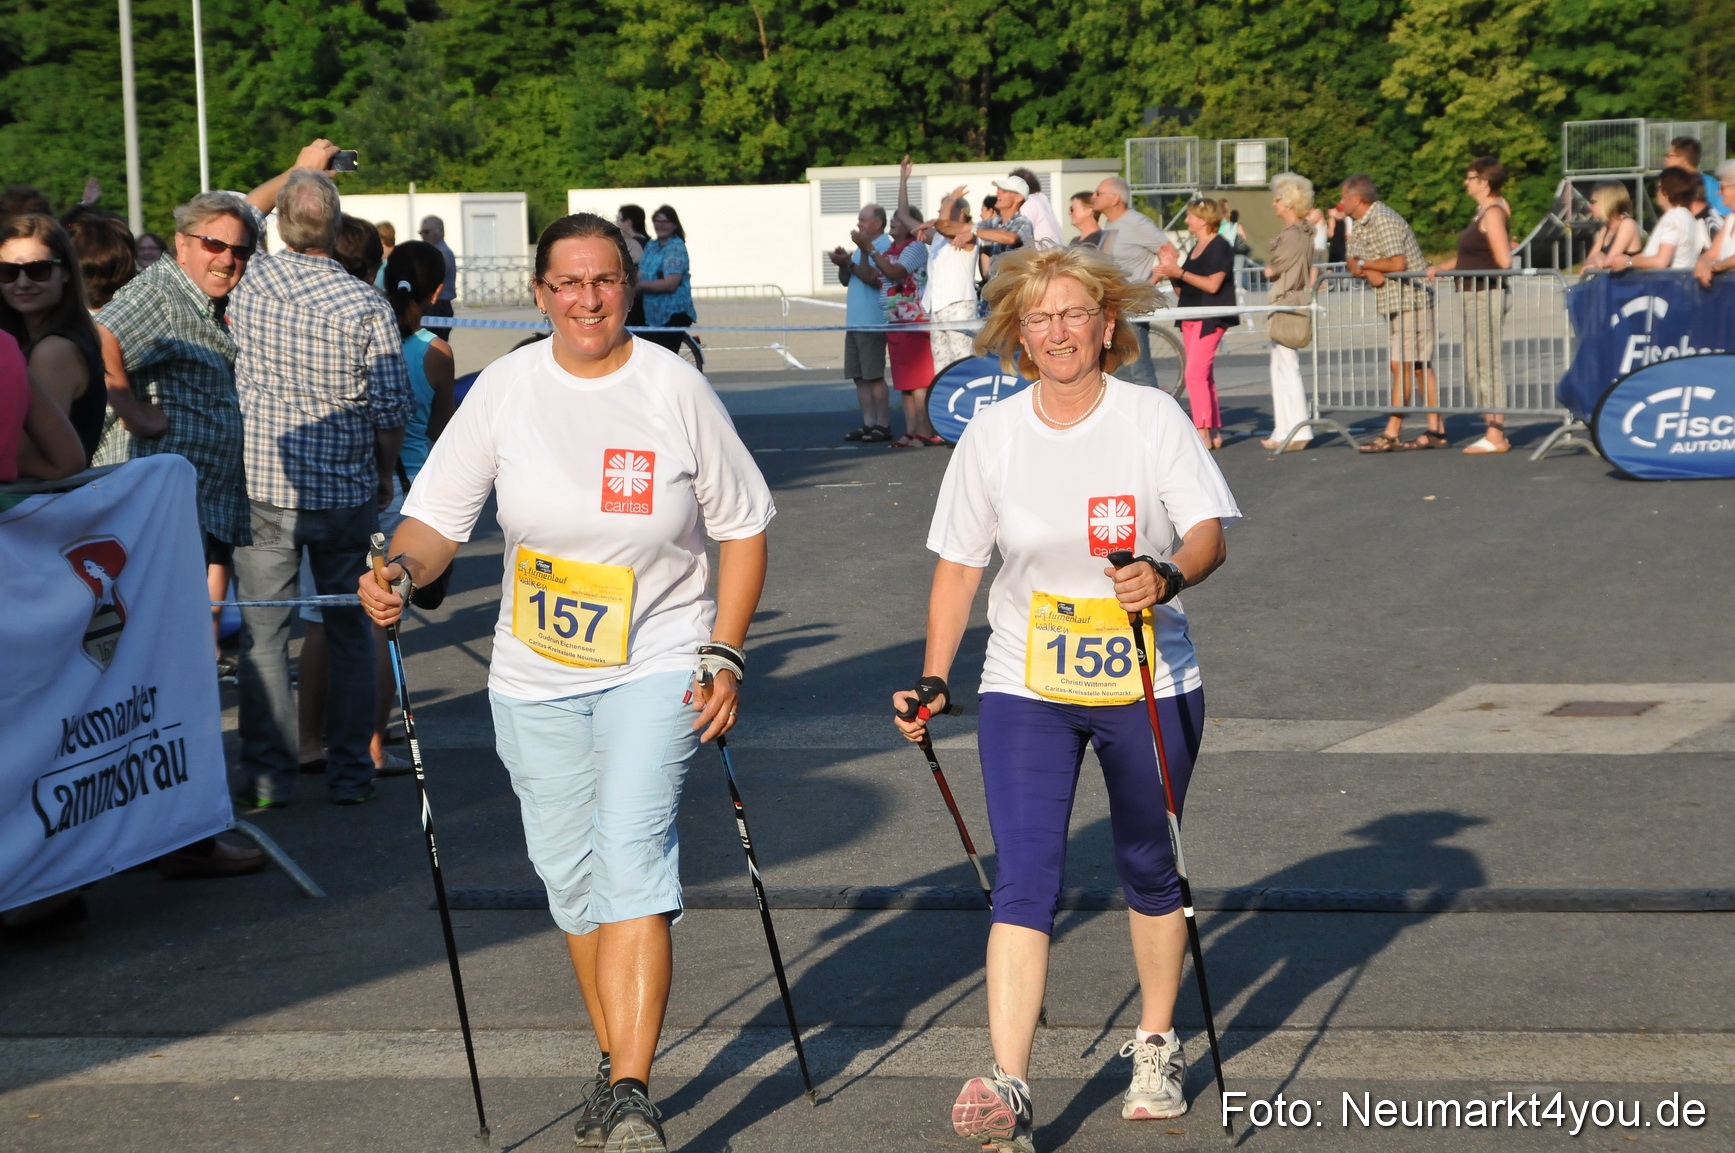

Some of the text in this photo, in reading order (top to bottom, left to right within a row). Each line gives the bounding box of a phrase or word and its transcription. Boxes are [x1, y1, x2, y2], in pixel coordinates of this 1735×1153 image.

[1619, 334, 1725, 374] Fisch
[1655, 411, 1735, 440] Fisc
[604, 499, 649, 513] caritas
[1093, 545, 1132, 557] carit
[528, 567, 568, 585] firmenlauf
[529, 590, 609, 643] 157
[1048, 611, 1091, 624] firmenlauf
[1035, 622, 1069, 634] walken
[528, 638, 576, 658] Caritas-Kreisstelle
[577, 653, 606, 664] Neumarkt
[538, 632, 596, 653] Gudrun Eichenseer
[1046, 634, 1132, 678] 158
[1045, 685, 1131, 696] Caritas-Kreisstelle Neumarkt
[1060, 678, 1083, 686] Christl
[31, 728, 190, 839] Lammsbräu
